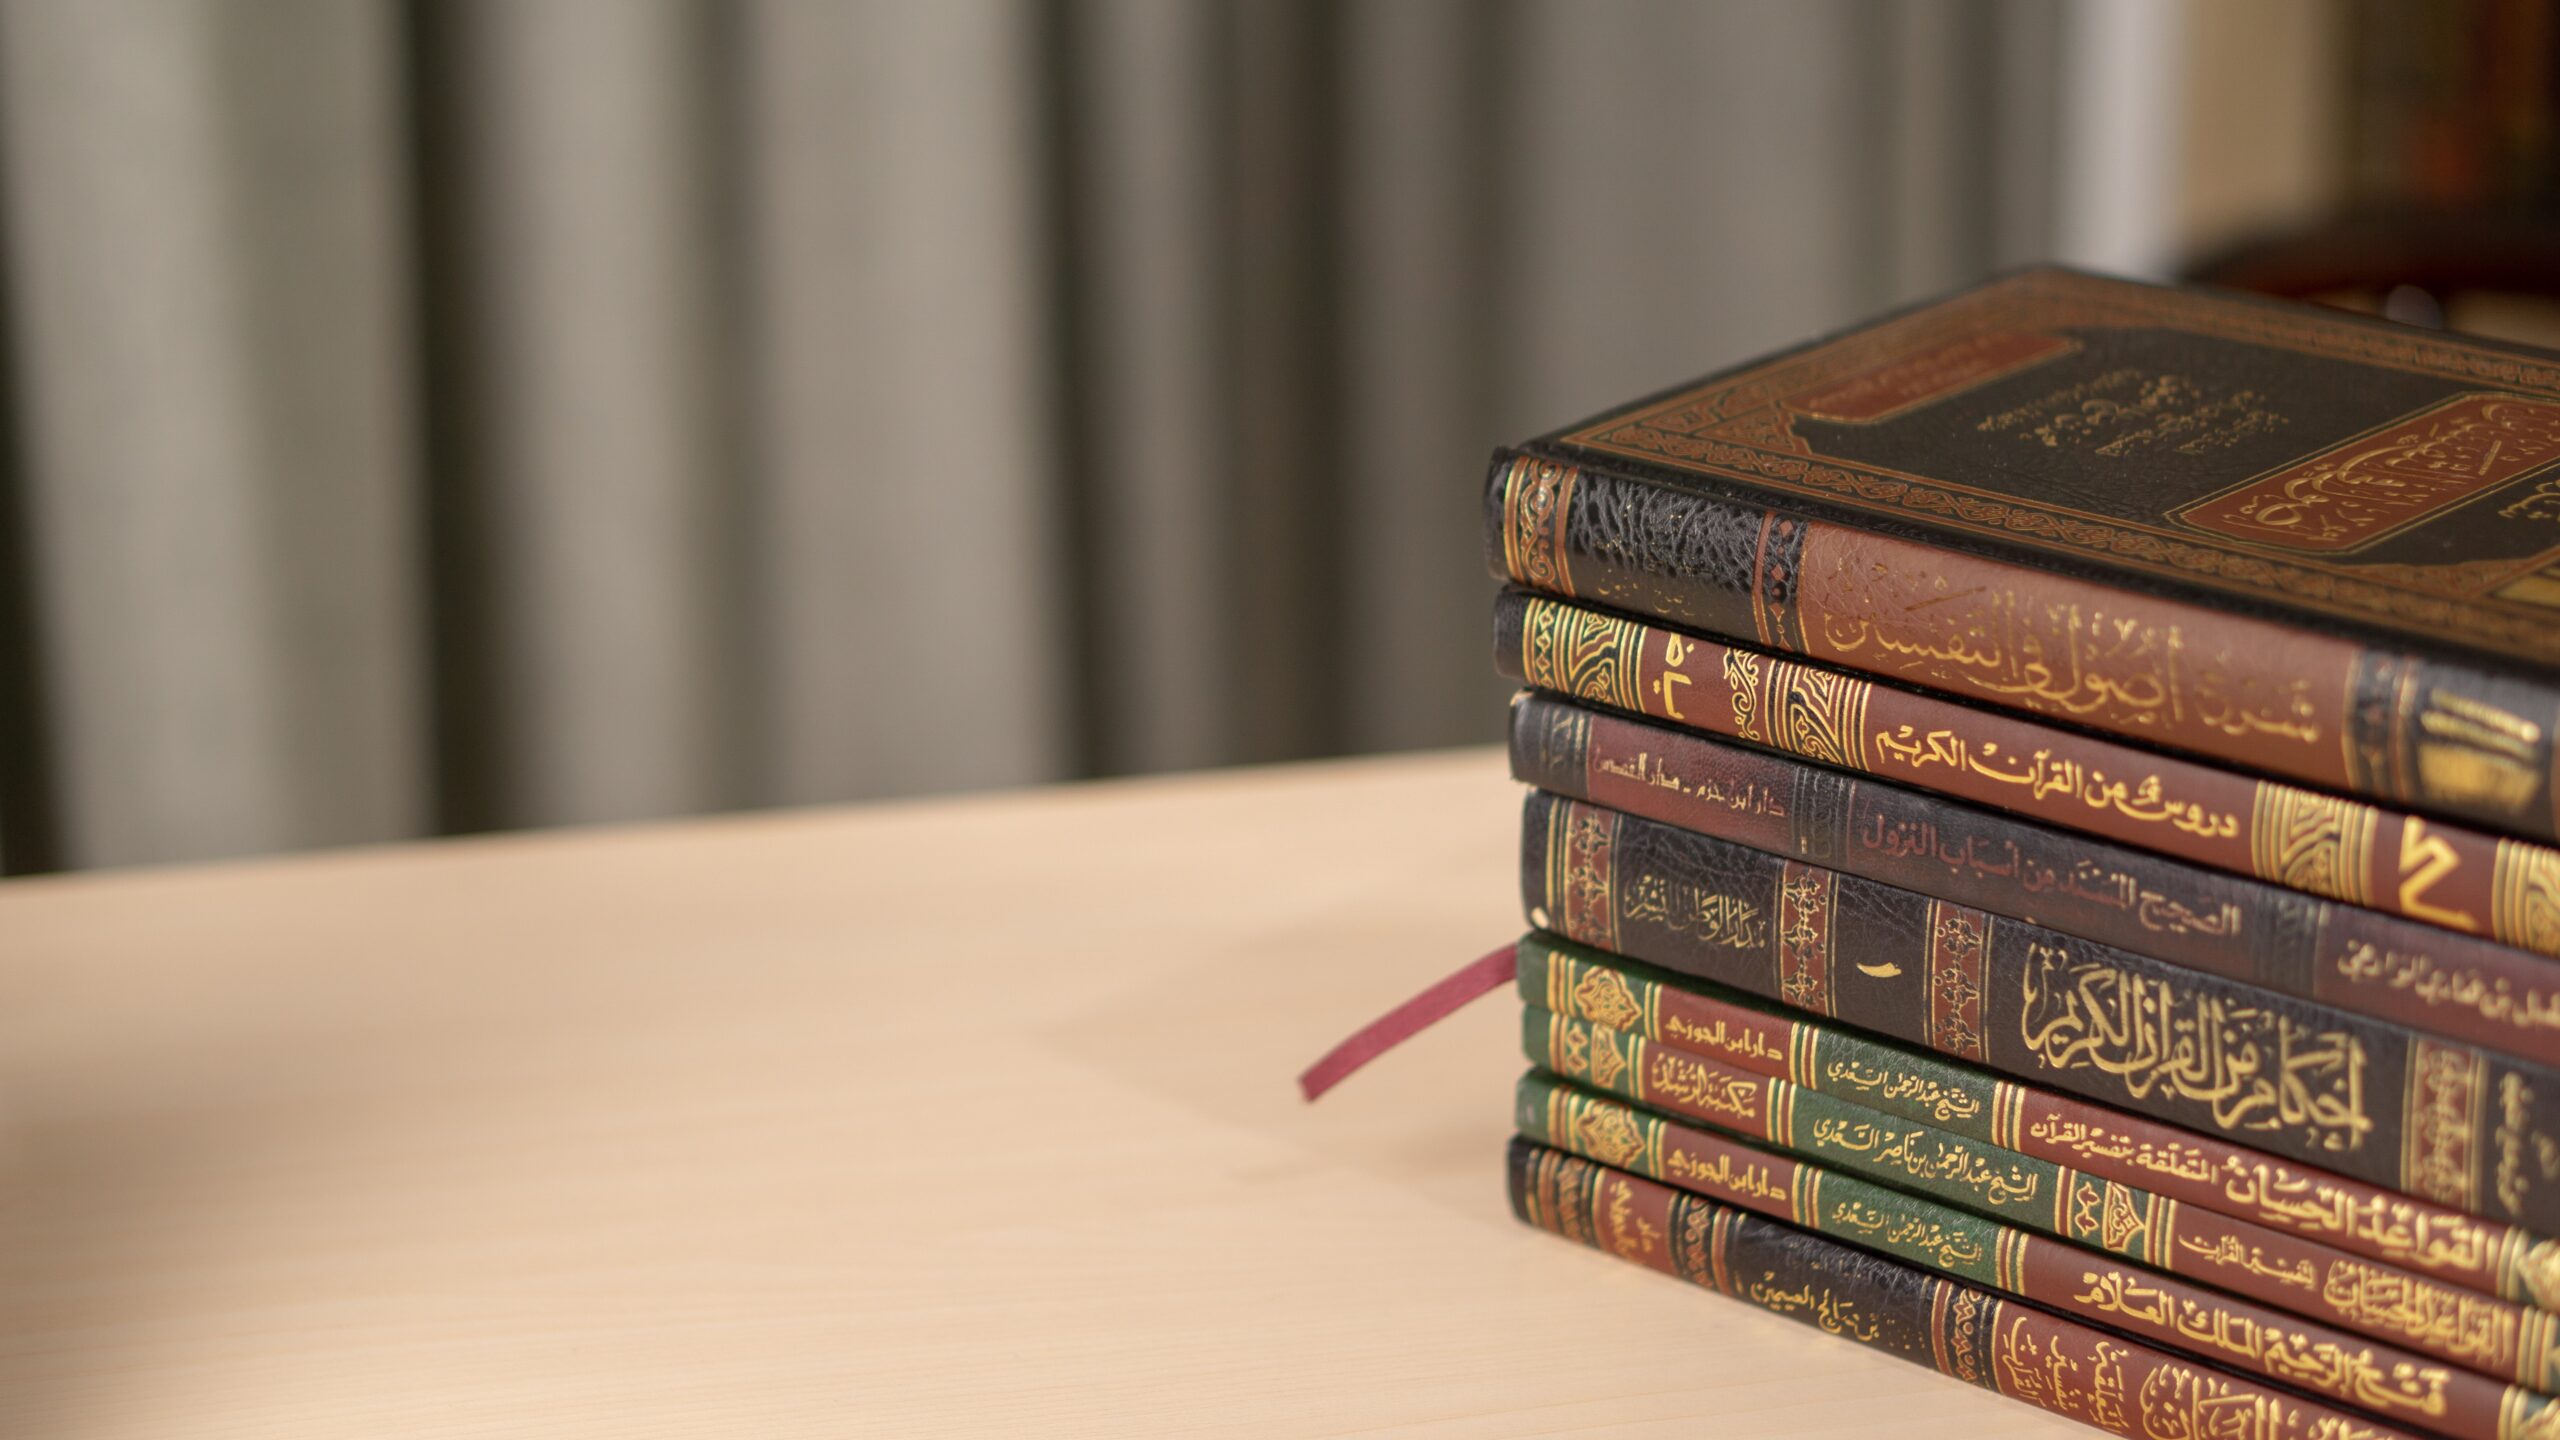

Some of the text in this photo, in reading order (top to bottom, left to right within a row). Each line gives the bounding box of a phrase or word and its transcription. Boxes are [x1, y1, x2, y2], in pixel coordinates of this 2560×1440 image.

[1876, 724, 1967, 772] الكريم
[1754, 786, 1785, 818] دار
[2084, 770, 2129, 808] من
[1862, 814, 1937, 858] النزول
[2022, 856, 2057, 892] من
[2060, 858, 2137, 908] المسند
[2139, 888, 2243, 936] الصحيح
[2021, 942, 2146, 1070] الكريم
[1664, 1015, 1783, 1062] دار ابن الجوزي
[1700, 1071, 1758, 1120] مكتبة
[1826, 1060, 1889, 1092] السعدي
[2212, 1014, 2373, 1150] أحكام
[1934, 1087, 1981, 1121] الشيخ
[1812, 1118, 1880, 1151] السعدي
[1872, 1131, 1922, 1165] ناصر
[1667, 1148, 1787, 1201] دار ابن الجوزي
[1987, 1164, 2039, 1205] الشيخ
[2029, 1113, 2500, 1274] القواعد الحسان المتعلقة بتفسير القرآن
[1831, 1201, 1890, 1233] السعدي
[1938, 1231, 1983, 1268] الشيخ
[2073, 1270, 2451, 1418] فتح الرحيم الملك العلام
[2044, 1335, 2081, 1412] بتفسير
